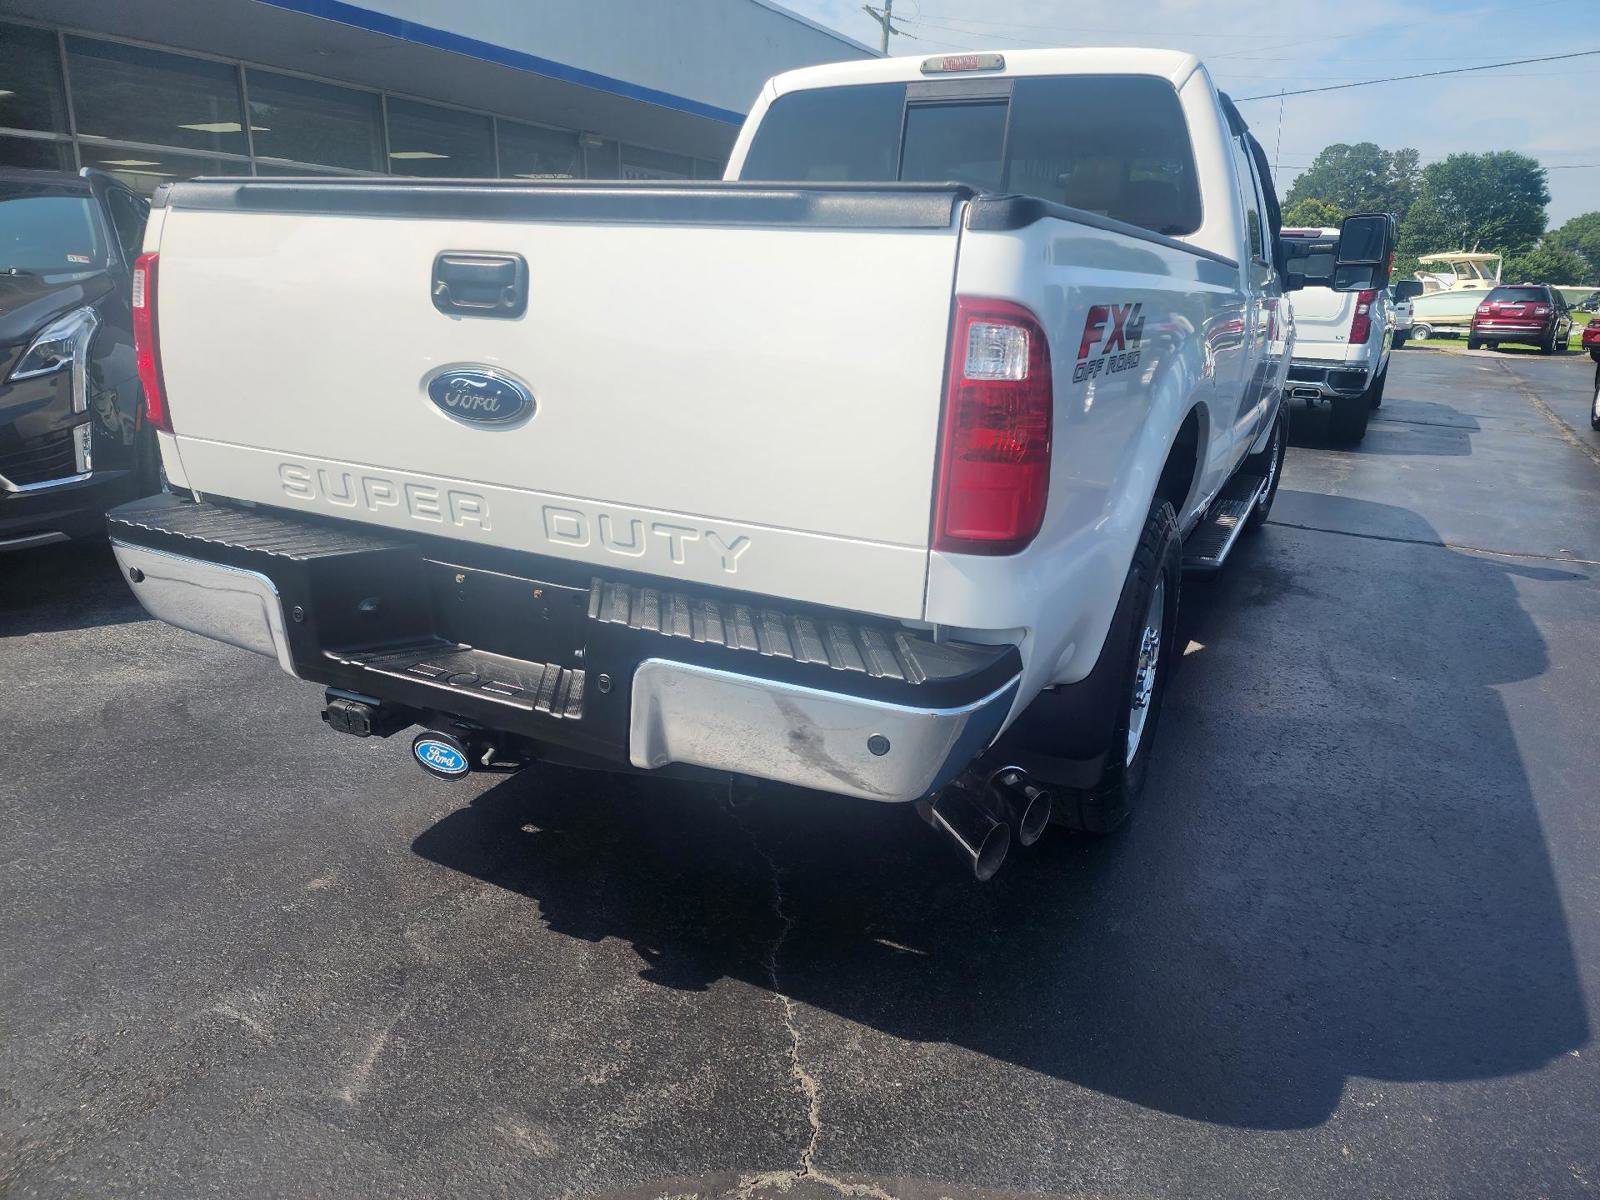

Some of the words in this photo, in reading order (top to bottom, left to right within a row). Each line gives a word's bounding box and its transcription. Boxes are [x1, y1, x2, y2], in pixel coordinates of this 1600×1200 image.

[1077, 303, 1146, 360] FX4
[1072, 358, 1105, 383] OFF
[1105, 351, 1142, 375] ROAD
[445, 377, 501, 412] Ford
[278, 462, 492, 531] SUPER
[541, 505, 752, 573] DUTY
[426, 745, 456, 767] Ford
